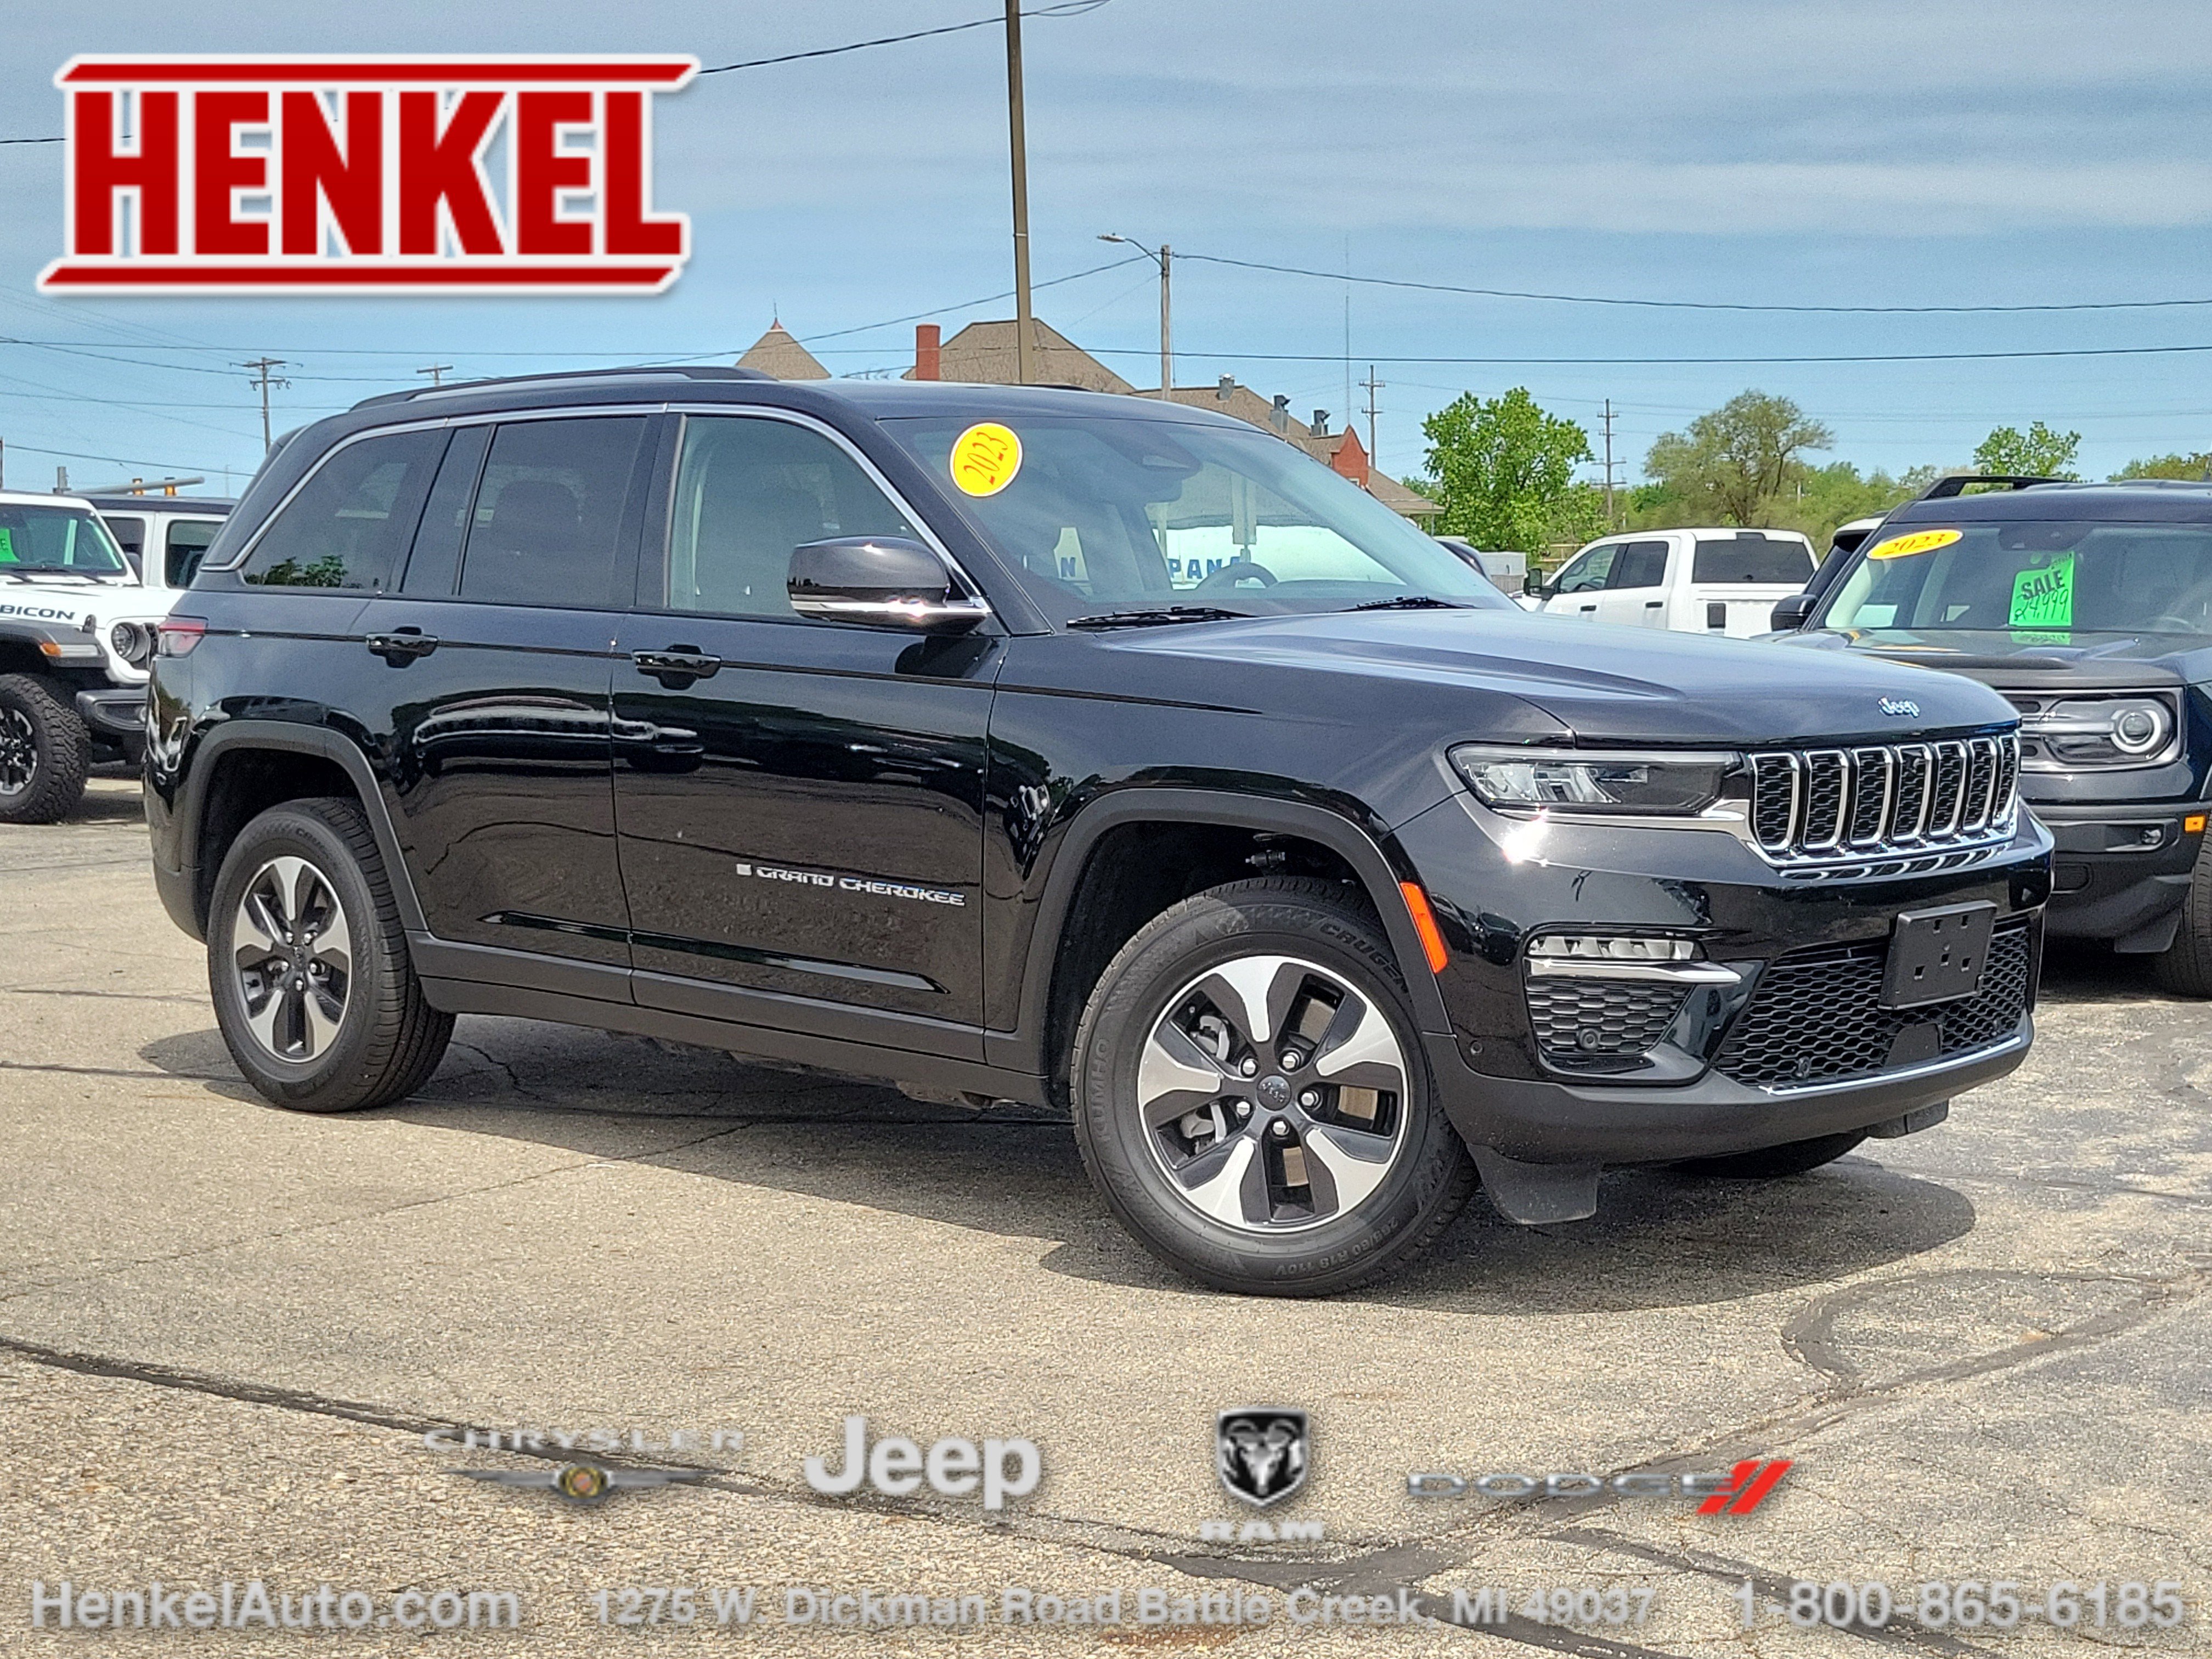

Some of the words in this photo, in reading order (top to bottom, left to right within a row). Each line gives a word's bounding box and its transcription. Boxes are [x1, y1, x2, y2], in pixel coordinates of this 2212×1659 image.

[963, 432, 1008, 485] 2023
[1883, 534, 1945, 555] 2023
[2021, 569, 2065, 600] SALE
[1878, 697, 1920, 719] Jeep
[755, 867, 834, 887] GRAND
[839, 878, 965, 906] CHEROKEE
